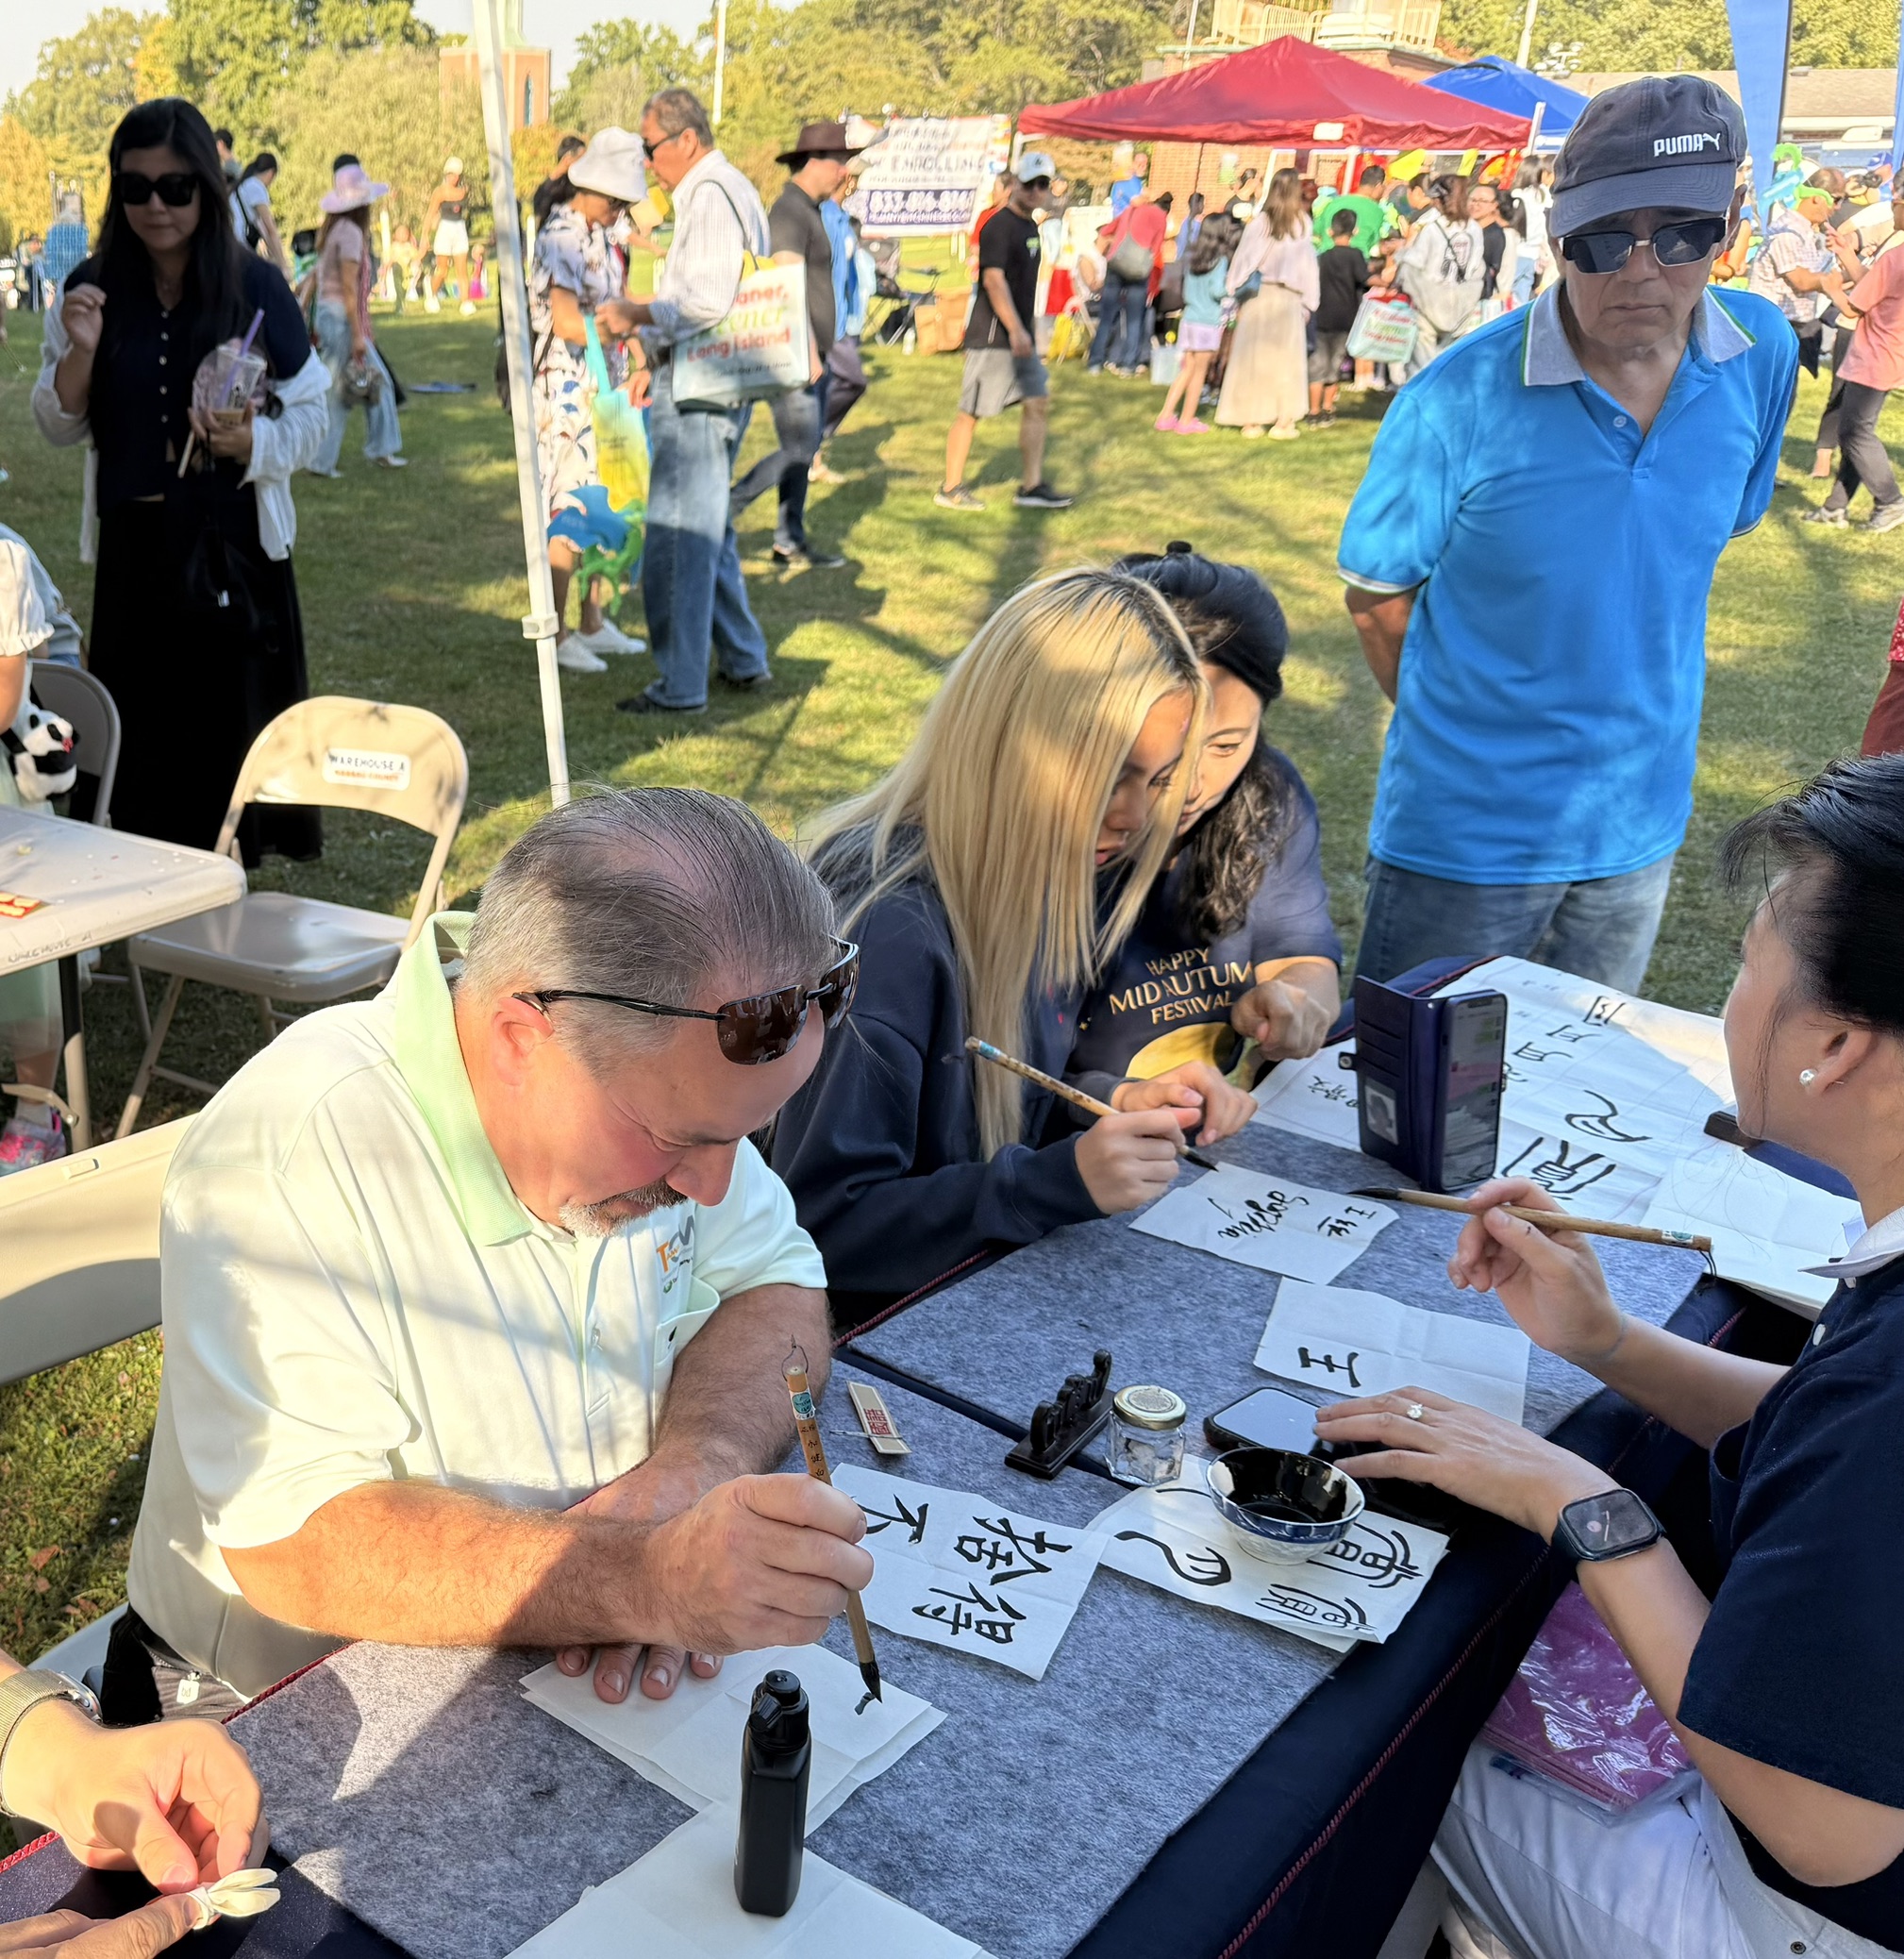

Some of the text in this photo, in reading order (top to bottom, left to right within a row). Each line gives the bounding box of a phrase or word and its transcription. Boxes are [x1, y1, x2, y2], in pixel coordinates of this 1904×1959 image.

[1653, 133, 1704, 157] PUMA
[687, 326, 791, 362] Long Island
[1145, 947, 1210, 976] HAPPY
[1151, 991, 1232, 1025] FESTIVAL
